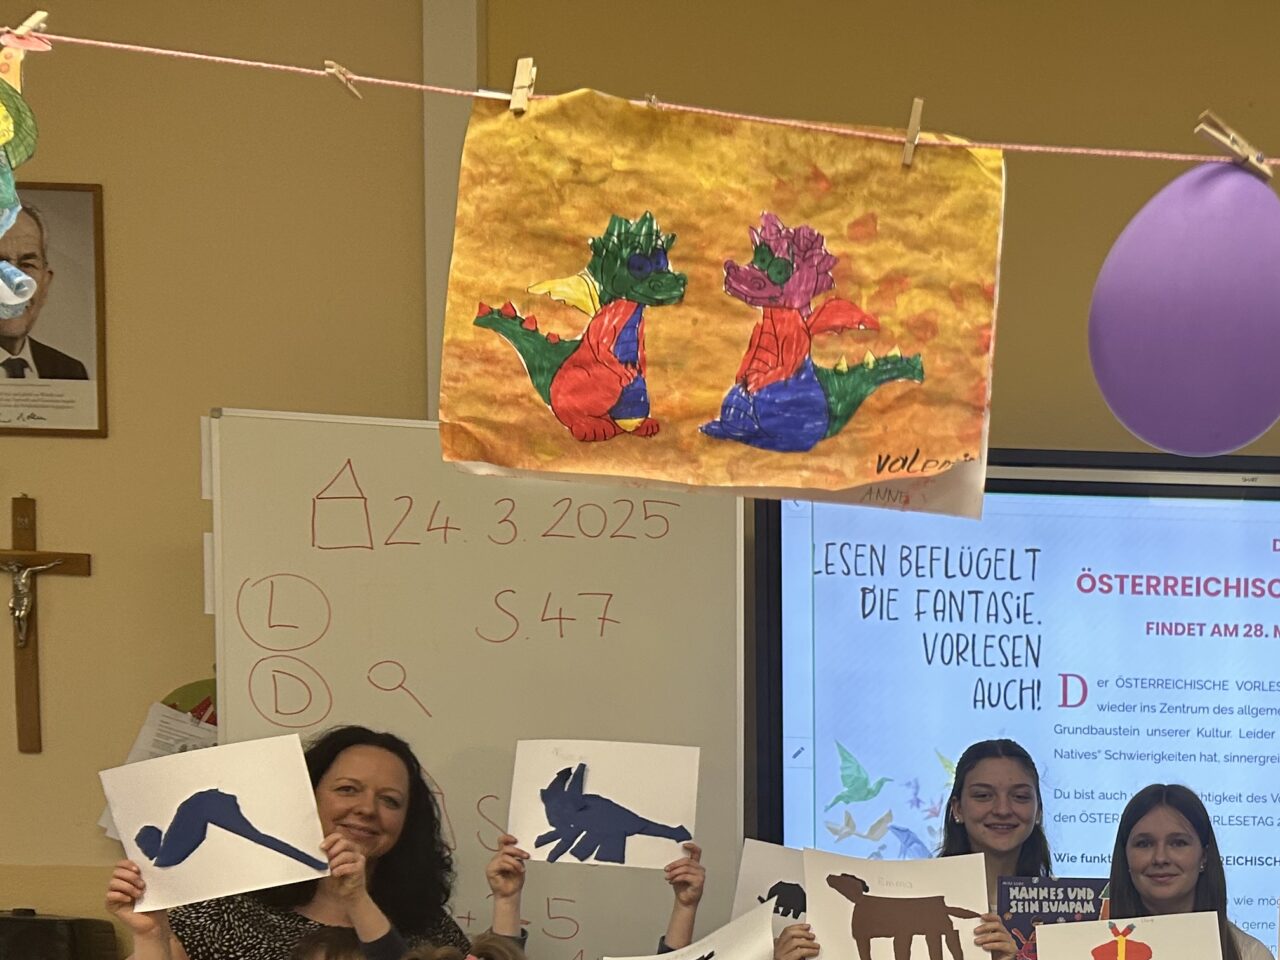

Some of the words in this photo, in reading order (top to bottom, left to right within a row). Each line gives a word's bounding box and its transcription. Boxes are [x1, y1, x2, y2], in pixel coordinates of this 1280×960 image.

[384, 494, 469, 547] 24.
[487, 497, 528, 546] 3.
[540, 496, 681, 541] 2025
[899, 545, 1042, 583] BEFLÜGELT
[267, 579, 299, 629] L
[860, 584, 900, 622] DIE
[539, 591, 622, 638] 47
[1145, 621, 1207, 638] FINDET
[1210, 622, 1240, 639] AM
[1243, 623, 1270, 639] 28.
[921, 632, 1042, 669] VORLESEN
[271, 668, 313, 715] D
[1115, 674, 1230, 692] ÖSTERREICHISCHE
[972, 677, 1043, 712] AUCH!
[1096, 701, 1138, 713] wieder
[1140, 702, 1157, 713] ins
[1159, 702, 1210, 715] Zentrum
[1213, 704, 1235, 715] des
[1053, 723, 1141, 737] Grundbaustein
[1146, 727, 1192, 738] unserer
[1239, 728, 1276, 740] Leider
[1104, 749, 1197, 765] Schwierigkeiten
[1053, 788, 1071, 800] Du
[1074, 787, 1096, 800] bist
[1097, 788, 1128, 801] auch
[1245, 792, 1268, 804] des
[1053, 812, 1077, 824] den
[1053, 852, 1078, 864] Wie
[1009, 886, 1064, 900] HANNES
[1067, 887, 1095, 900] UND
[1233, 896, 1255, 906] wie
[1009, 900, 1042, 914] SEIN
[1042, 901, 1096, 914] BUMPAM
